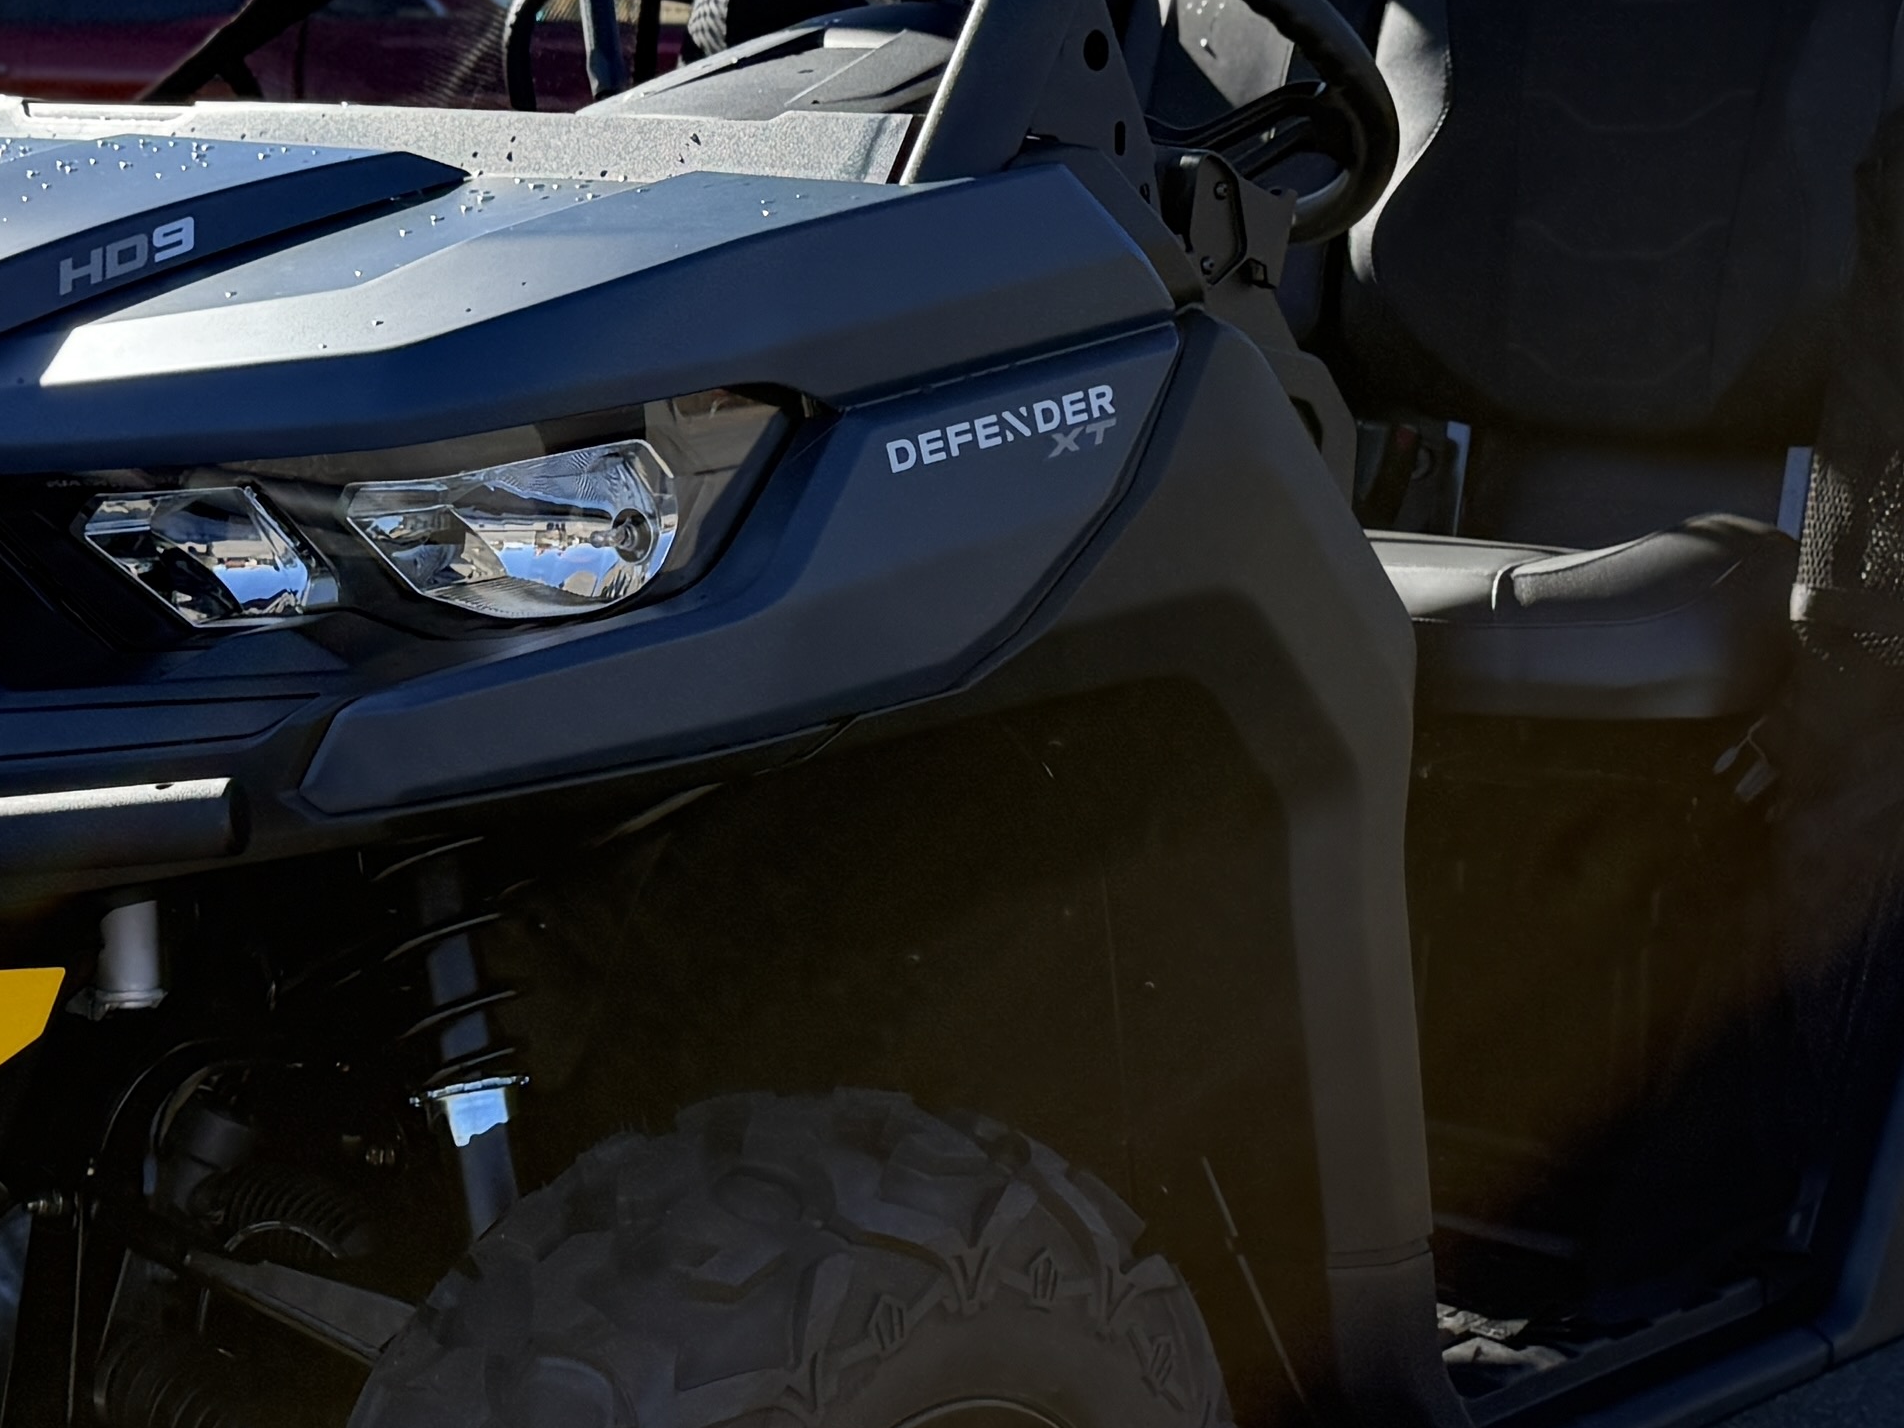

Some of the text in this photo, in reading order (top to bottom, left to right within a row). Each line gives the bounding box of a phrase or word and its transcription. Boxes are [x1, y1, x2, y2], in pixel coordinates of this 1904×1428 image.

[59, 217, 195, 296] HD9
[886, 384, 1116, 474] DEFENDER
[1048, 418, 1117, 459] XT
